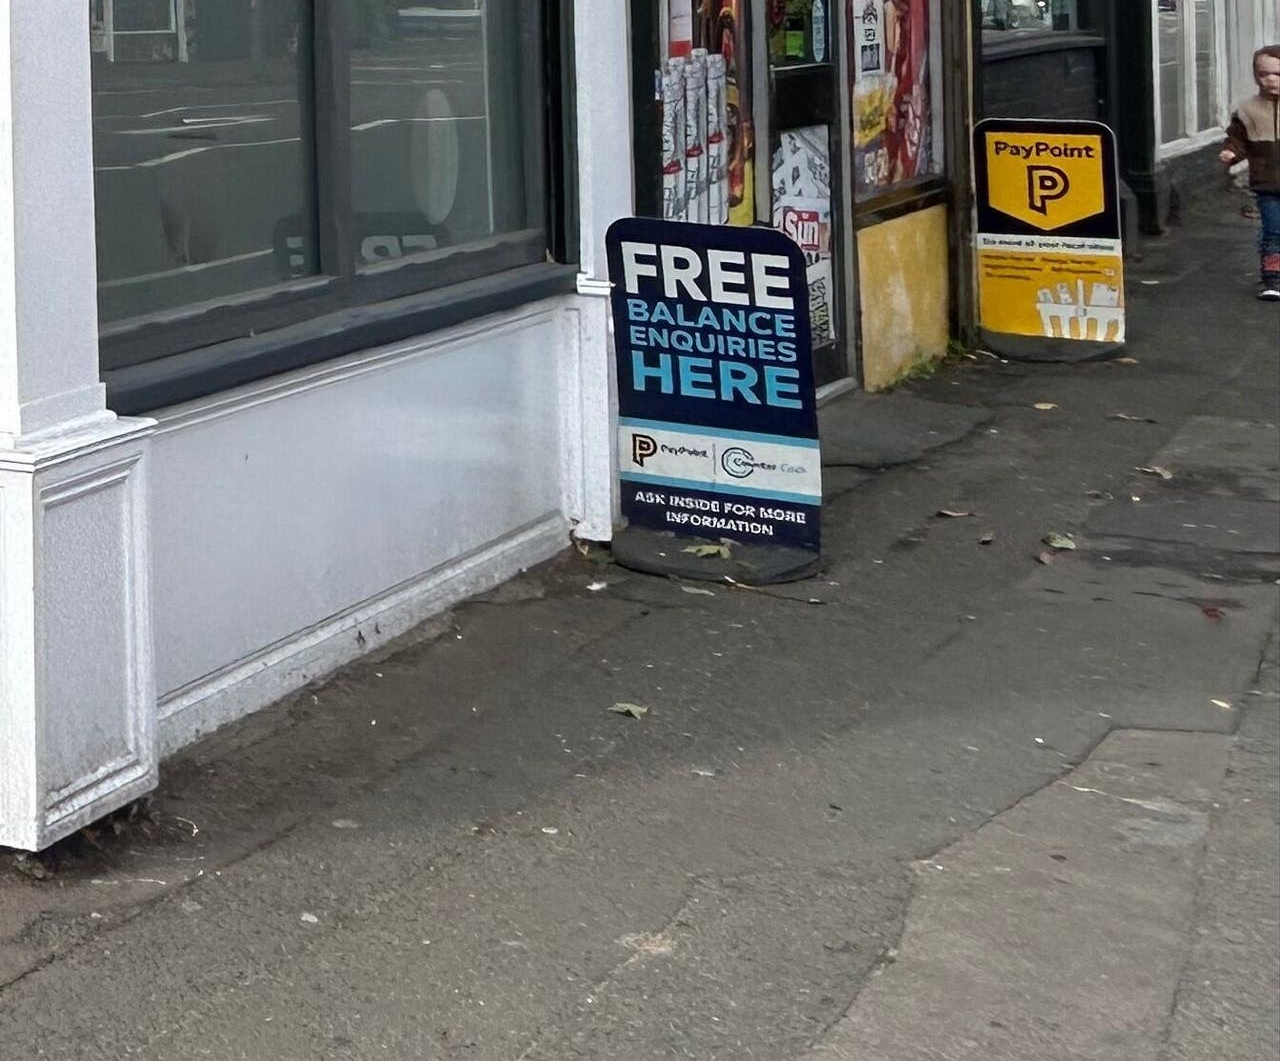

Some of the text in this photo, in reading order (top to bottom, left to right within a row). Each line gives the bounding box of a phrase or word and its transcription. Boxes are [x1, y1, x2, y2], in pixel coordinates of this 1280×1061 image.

[994, 141, 1096, 159] PayPoint
[784, 210, 819, 245] Sun
[620, 241, 795, 309] FREE
[626, 299, 797, 338] BALANCE
[630, 325, 797, 362] ENQUIRIES
[632, 351, 803, 409] HERE
[635, 491, 807, 524] ASK INSIDE FOR MORE
[666, 511, 774, 535] INFORMATION
